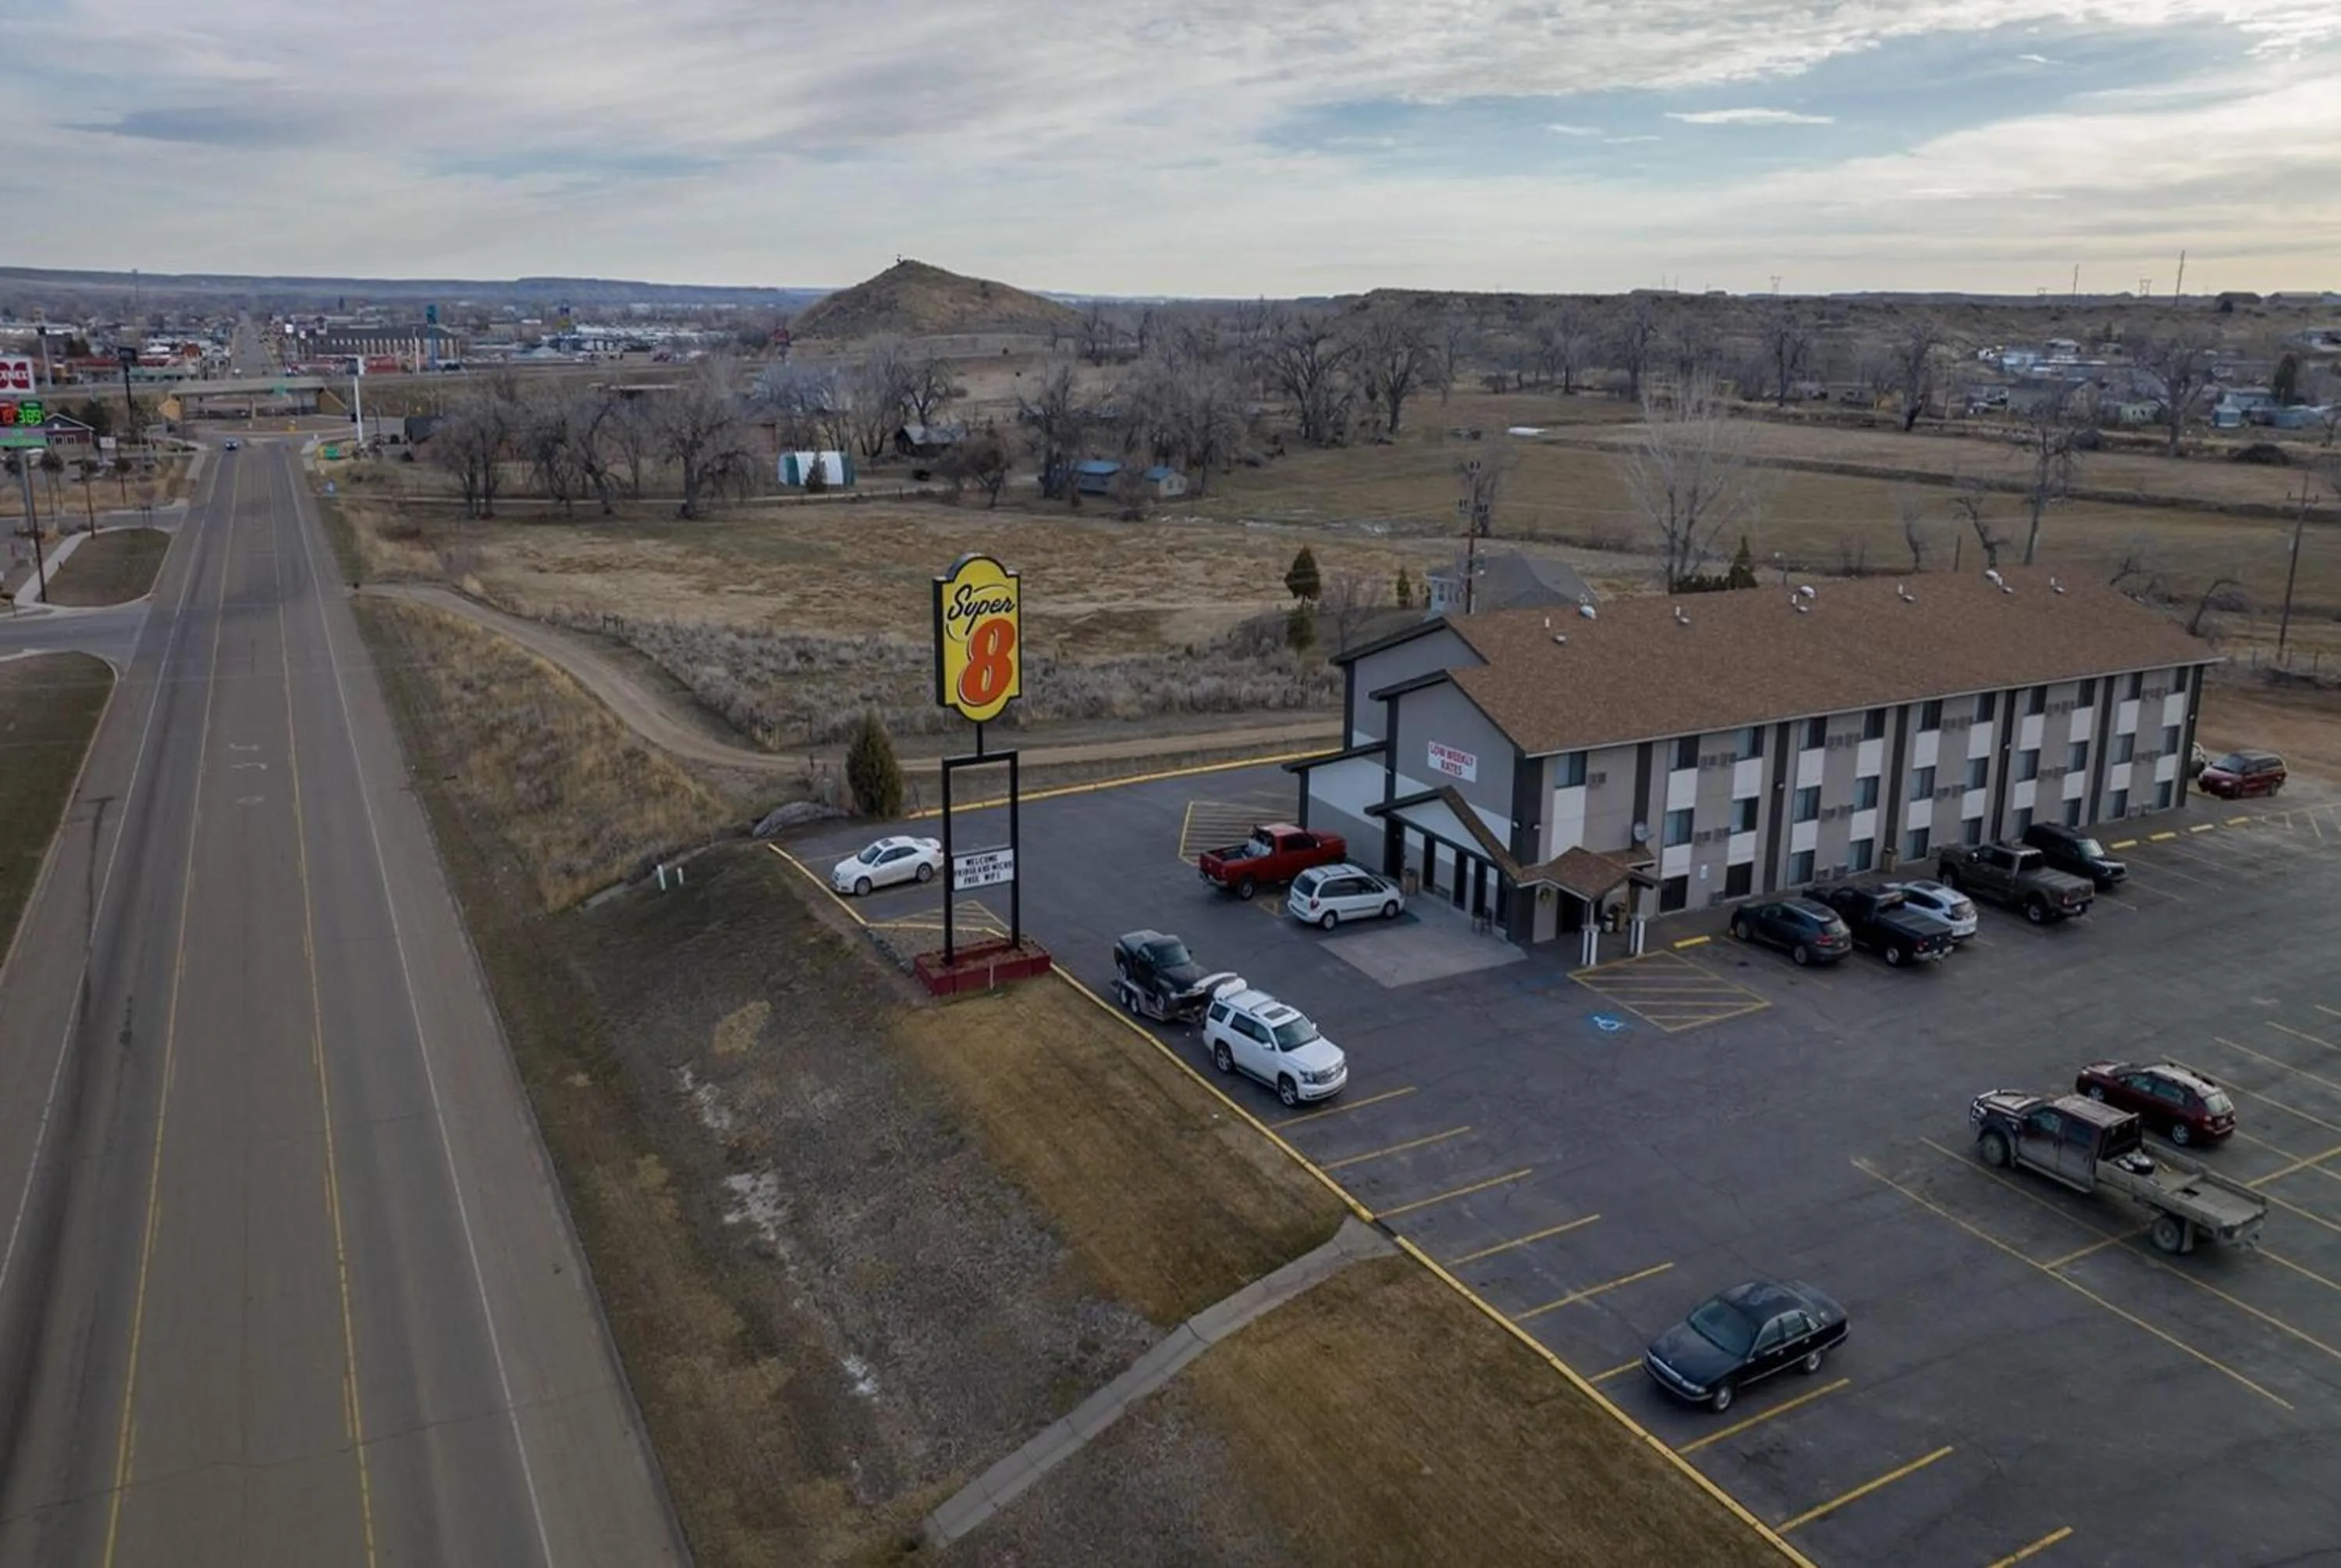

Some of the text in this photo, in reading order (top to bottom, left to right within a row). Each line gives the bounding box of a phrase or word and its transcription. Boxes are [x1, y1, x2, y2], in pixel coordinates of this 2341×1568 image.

[947, 584, 1015, 636] Super
[957, 618, 1015, 707] 8
[1430, 743, 1474, 767] LOW WEEKLY
[1440, 759, 1462, 775] RATES
[965, 854, 997, 865] WELCOME
